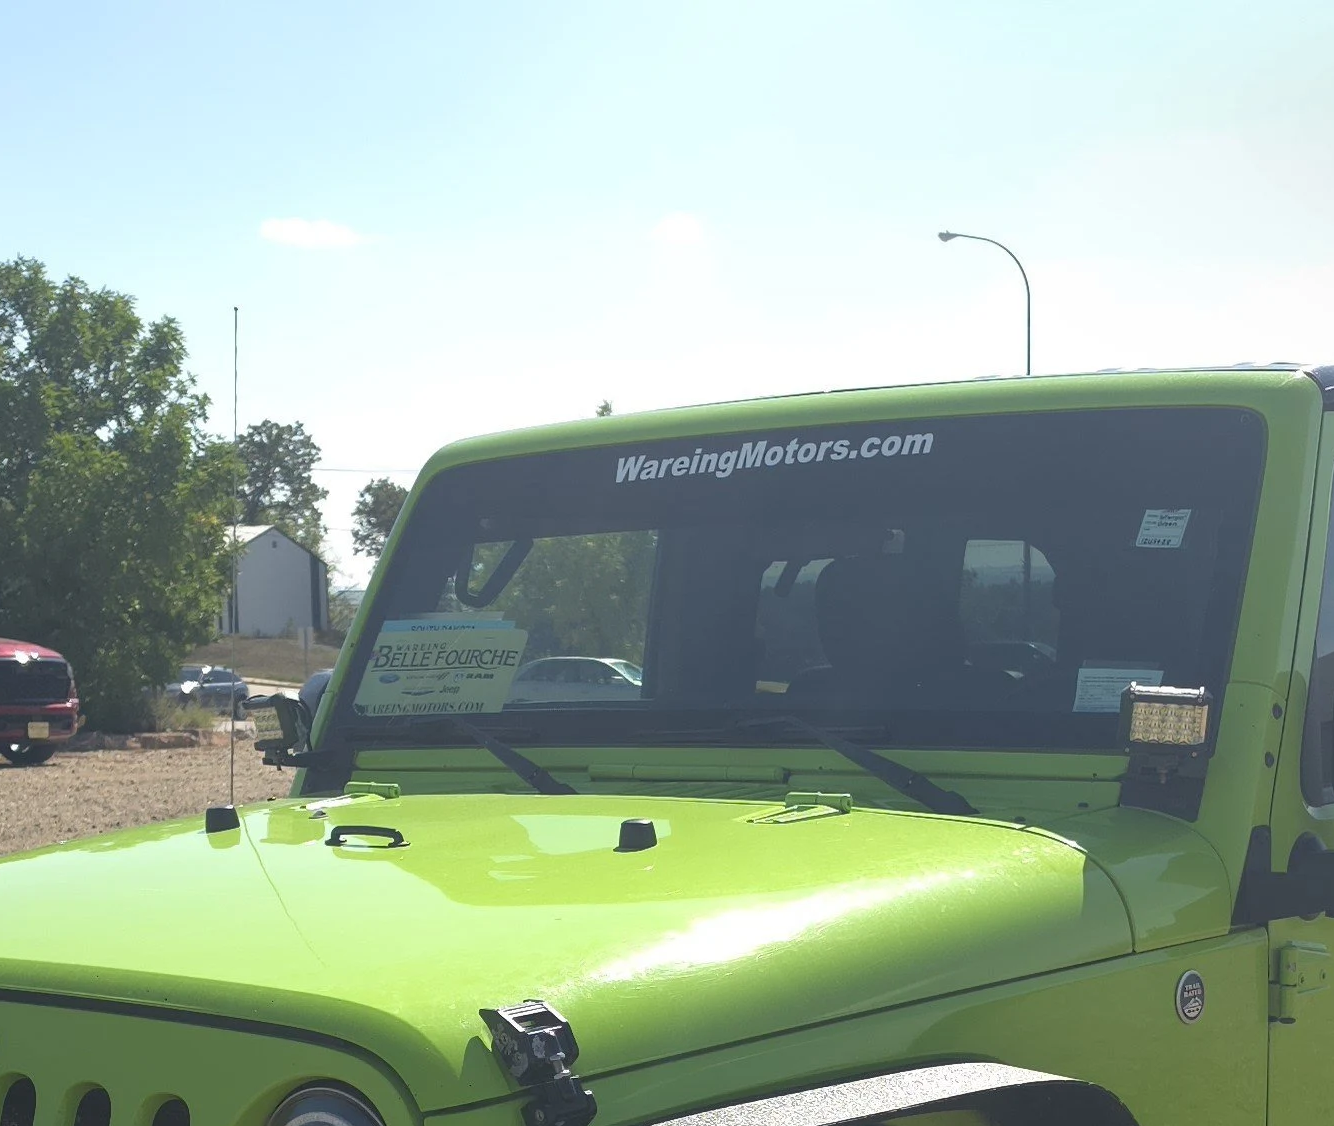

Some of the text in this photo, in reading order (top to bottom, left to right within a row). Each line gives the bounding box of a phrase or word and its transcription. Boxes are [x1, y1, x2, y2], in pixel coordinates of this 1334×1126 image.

[614, 432, 935, 483] WareingMotors.com
[373, 645, 519, 670] BELLE FOURCHE
[395, 641, 448, 653] WAREING
